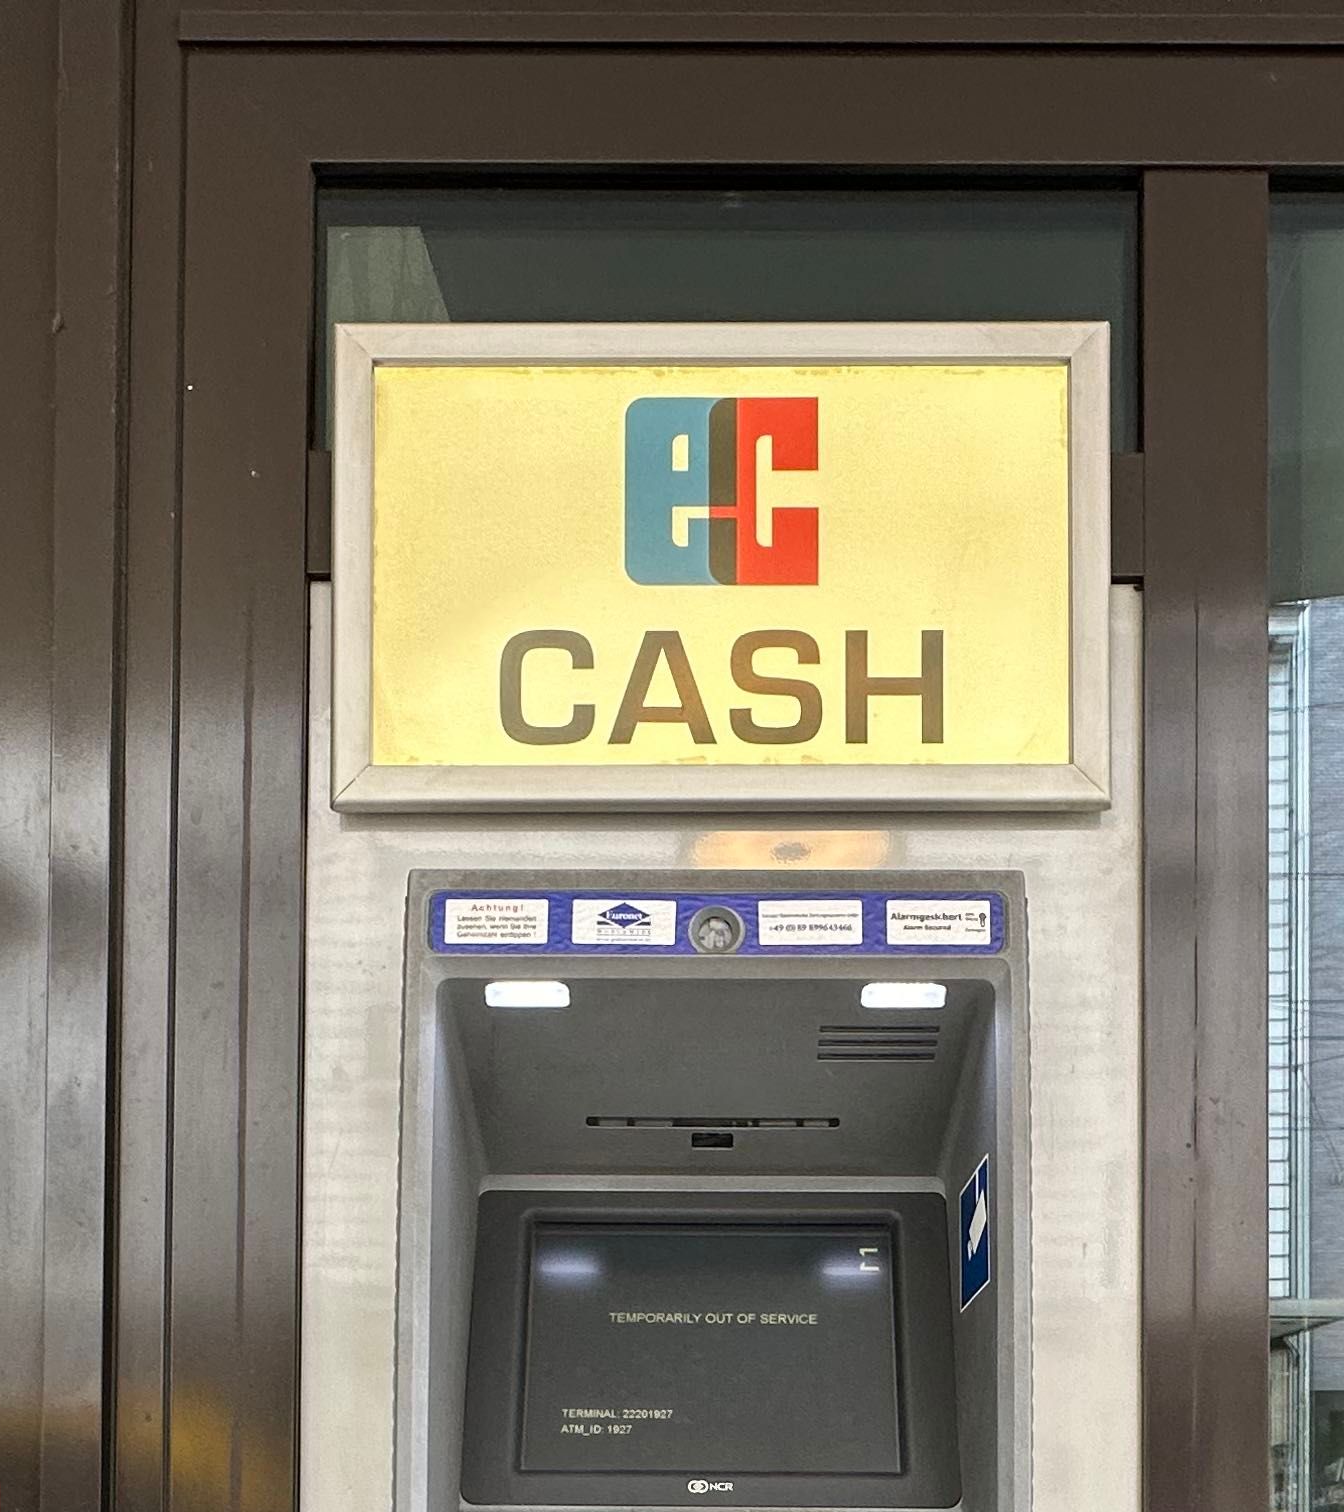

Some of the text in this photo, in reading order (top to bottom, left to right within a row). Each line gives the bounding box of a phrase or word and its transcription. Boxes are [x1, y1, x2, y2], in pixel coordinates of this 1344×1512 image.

[499, 629, 945, 746] CASH
[472, 904, 524, 913] Achtung!
[609, 1312, 818, 1325] TEMPORARILY OUT OF SERVICE
[561, 1408, 673, 1419] TERMINAL: 22201927
[560, 1425, 633, 1436] ATM_ID: 1927
[709, 1482, 733, 1491] NCR
